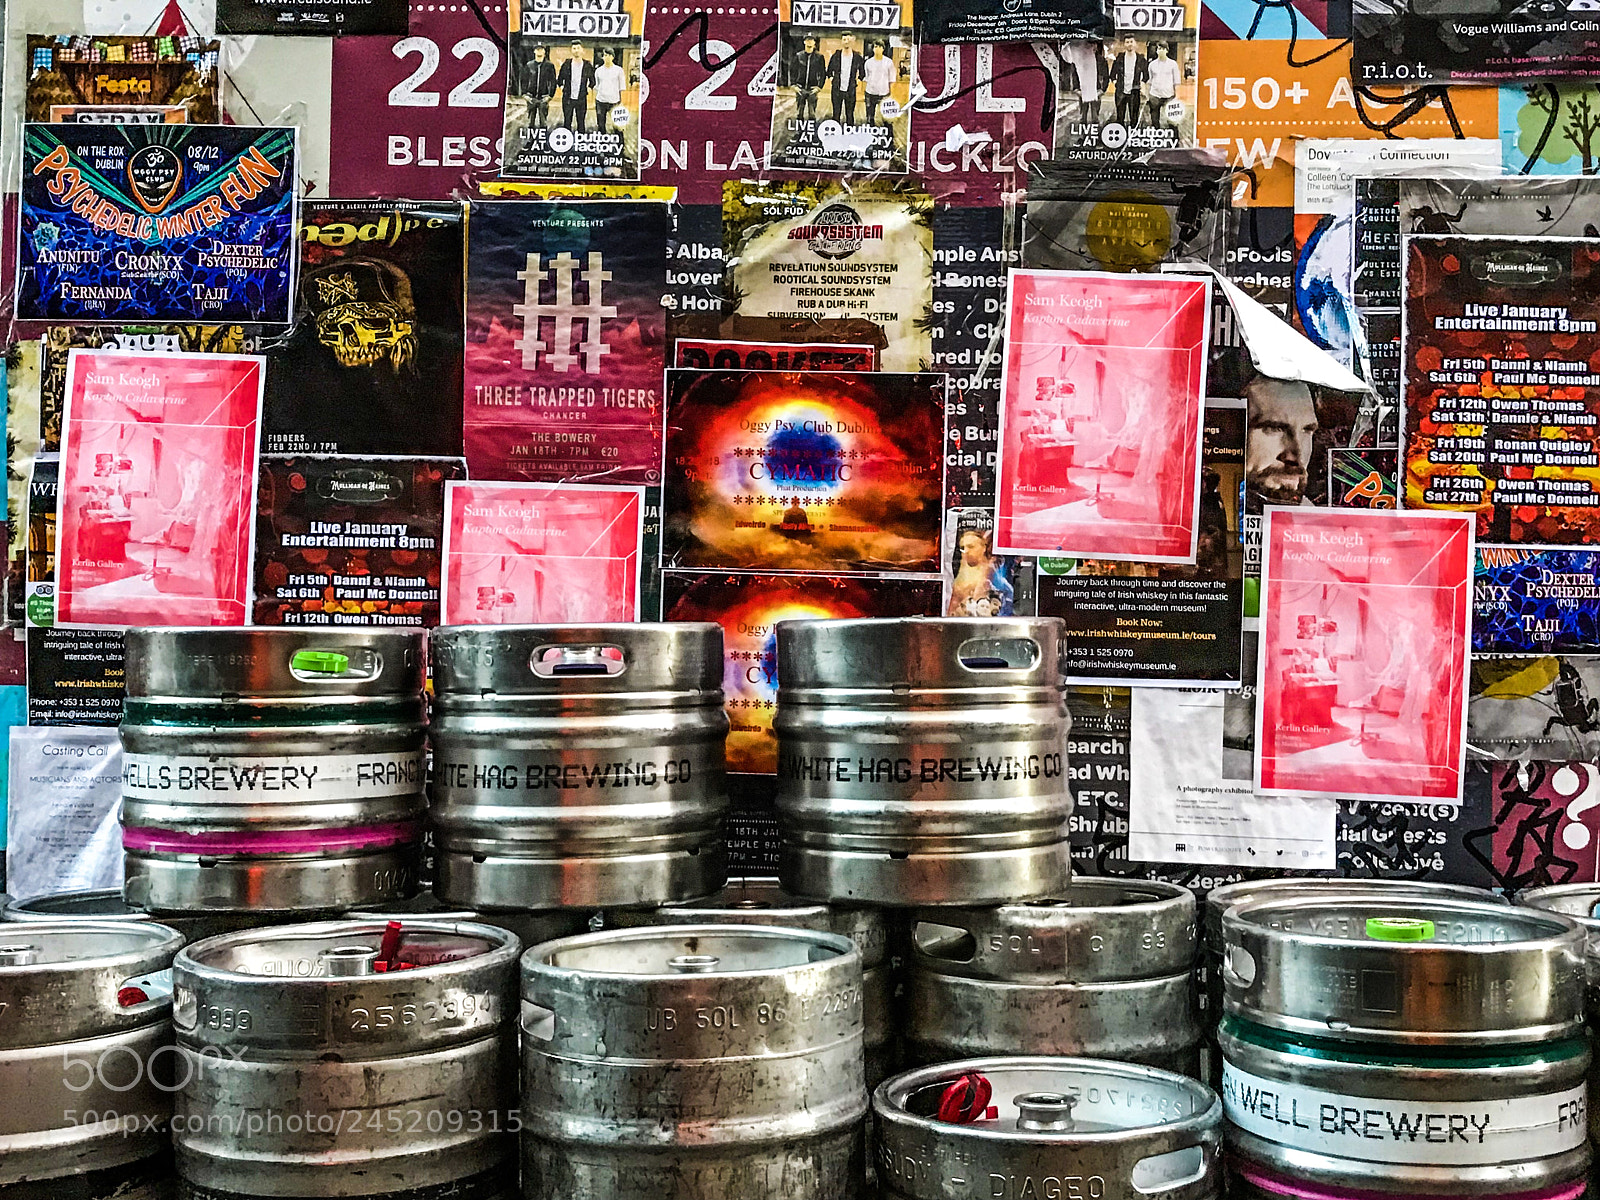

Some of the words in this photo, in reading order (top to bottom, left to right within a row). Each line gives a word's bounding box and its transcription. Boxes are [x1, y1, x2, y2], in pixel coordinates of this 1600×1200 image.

[794, 1, 899, 26] MELODY
[524, 14, 627, 34] MELODY
[1453, 24, 1488, 36] Vogue
[1491, 23, 1542, 33] Williams
[1545, 21, 1567, 31] and
[1570, 21, 1599, 31] Colin
[388, 37, 500, 107] 22
[1363, 61, 1432, 79] r.i.o.t.
[96, 75, 151, 93] Festa
[1203, 78, 1309, 109] 150+
[788, 120, 814, 130] LIVE
[1071, 124, 1098, 135] LIVE
[520, 128, 546, 139] LIVE
[575, 131, 619, 142] button
[800, 132, 813, 142] AT
[1128, 126, 1174, 137] button
[531, 141, 545, 150] AT
[1083, 136, 1098, 146] AT
[77, 146, 89, 156] ON
[91, 146, 106, 156] THE
[109, 146, 124, 156] ROX
[188, 146, 218, 159] 08/12
[574, 142, 623, 155] factory
[518, 155, 566, 164] SATURDAY
[1069, 151, 1119, 160] SATURDAY
[96, 159, 123, 169] DUBLIN
[194, 162, 209, 174] 9pm
[33, 144, 152, 240] PSYCHEDELIC
[157, 197, 229, 239] WINTER
[220, 146, 280, 209] FUN
[211, 241, 262, 256] DEXTER
[36, 249, 99, 263] ANUNITU
[115, 251, 183, 271] CRONYX
[198, 252, 278, 268] PSYCHEDELIC
[828, 264, 897, 272] SOUNDSYSTEM
[821, 276, 890, 284] SOUNDSYSTEM
[60, 283, 132, 299] FERNANDA
[791, 288, 841, 296] FIREHOUSE
[844, 288, 875, 296] SKANK
[798, 300, 816, 308] RUB
[818, 300, 824, 308] A
[1025, 293, 1054, 306] Sam
[1060, 295, 1102, 310] Keogh
[1466, 304, 1498, 318] Live
[1502, 305, 1567, 320] January
[1435, 317, 1556, 330] Entertainment
[1559, 319, 1596, 332] 8pm
[1466, 360, 1486, 370] 5th
[1533, 361, 1542, 371] &
[86, 372, 114, 385] Sam
[119, 373, 160, 389] Keogh
[1430, 372, 1451, 383] Sat
[1454, 372, 1476, 383] 6th
[1494, 373, 1523, 384] Paul
[1526, 374, 1546, 384] Mc
[476, 386, 521, 405] THREE
[530, 387, 595, 406] TRAPPED
[603, 388, 655, 408] TIGERS
[1459, 399, 1486, 410] 12th
[1492, 400, 1528, 411] Owen
[1532, 400, 1584, 411] Thomas
[1432, 412, 1454, 422] Sat
[1456, 412, 1484, 423] 13th
[740, 419, 770, 433] Oggy
[775, 420, 796, 432] Psy
[803, 420, 832, 433] Club
[532, 432, 550, 442] THE
[555, 433, 596, 442] BOWERY
[268, 442, 285, 450] FEB
[320, 442, 337, 450] 7PM
[511, 446, 528, 454] JAN
[601, 447, 618, 456] €20
[1458, 439, 1485, 450] 19th
[1494, 440, 1537, 451] Ronan
[1540, 440, 1590, 453] Quigley
[1430, 452, 1452, 462] Sat
[1455, 452, 1485, 463] 20th
[1490, 453, 1519, 464] Paul
[1546, 454, 1597, 466] Donnell
[750, 463, 852, 481] CYMATIC
[1013, 484, 1035, 492] Kerlin
[1456, 478, 1483, 490] 26th
[1498, 480, 1534, 490] Owen
[1537, 480, 1590, 491] Thomas
[1426, 491, 1449, 502] Sat
[1451, 491, 1478, 503] 27th
[1494, 492, 1522, 503] Paul
[1526, 493, 1545, 504] Mc
[1548, 493, 1599, 505] Donnell
[464, 504, 493, 516] Sam
[498, 506, 539, 520] Keogh
[311, 522, 341, 534] Live
[344, 523, 407, 536] January
[282, 534, 395, 547] Entertainment
[398, 537, 435, 549] 8pm
[1283, 530, 1314, 544] Sam
[1319, 532, 1363, 547] Keogh
[307, 575, 327, 585] 5th
[1541, 569, 1595, 585] DEXTER
[1056, 579, 1087, 587] Journey
[1111, 579, 1140, 588] through
[1178, 580, 1212, 588] discover
[277, 588, 297, 598] Sat
[299, 588, 320, 598] 6th
[336, 588, 364, 598] Paul
[367, 589, 386, 599] Mc
[1054, 591, 1089, 599] intriguing
[1074, 603, 1117, 611] interactive,
[303, 614, 329, 623] 12th
[334, 615, 368, 624] Owen
[371, 615, 422, 624] Thomas
[1117, 618, 1138, 626] Book
[1140, 619, 1163, 627] Now:
[44, 642, 78, 650] intriguing
[30, 698, 56, 706] Phone:
[59, 698, 77, 706] +353
[43, 745, 84, 757] Casting
[789, 757, 850, 782] WHITE
[859, 757, 912, 782] HAG
[920, 755, 1039, 782] BREWING
[1044, 753, 1061, 778] CO
[179, 766, 318, 790] BREWERY
[474, 764, 518, 789] HAG
[526, 762, 657, 789] BREWING
[664, 760, 691, 783] CO
[1184, 785, 1223, 794] photography
[1241, 1085, 1308, 1128] WELL
[1320, 1104, 1489, 1143] BREWERY
[989, 1174, 1105, 1199] DIAGEO
